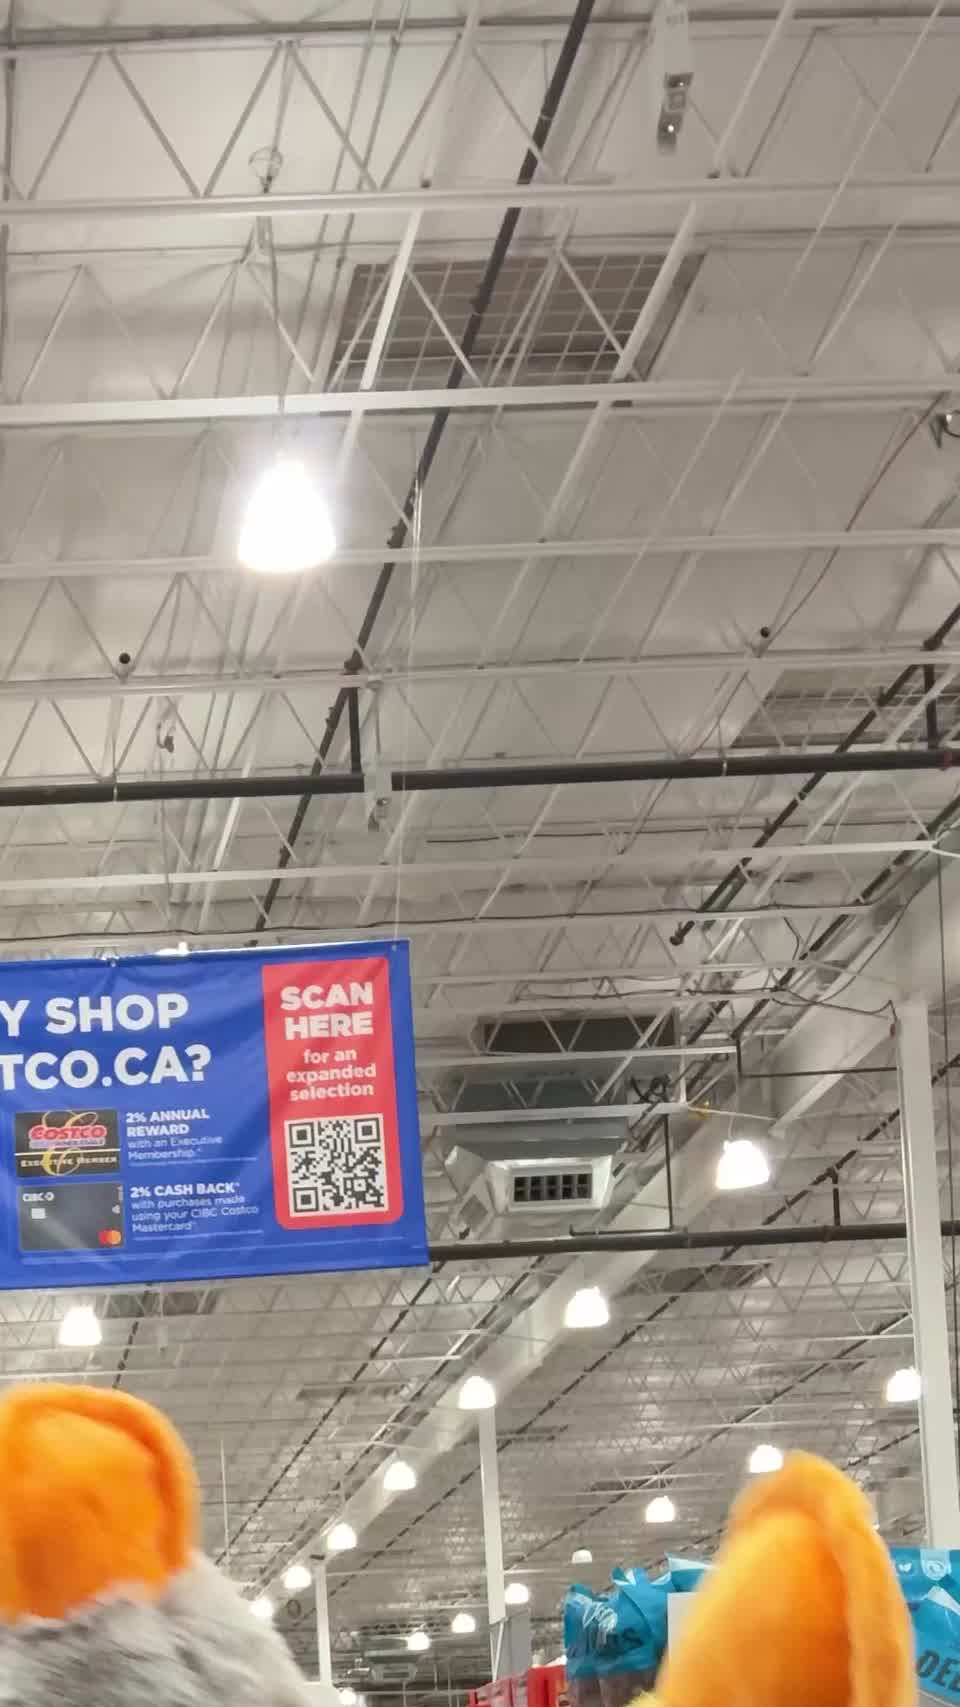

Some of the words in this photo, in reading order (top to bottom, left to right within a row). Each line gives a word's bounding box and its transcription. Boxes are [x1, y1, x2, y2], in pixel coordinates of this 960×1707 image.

[280, 981, 374, 1011] SCAN
[44, 992, 190, 1035] SHOP
[284, 1011, 374, 1040] HERE
[303, 1048, 330, 1064] for
[334, 1048, 357, 1062] an
[286, 1062, 377, 1085] expanded
[289, 1082, 375, 1102] selection
[126, 1112, 147, 1124] 2%
[150, 1108, 210, 1122] ANNUAL
[28, 1125, 108, 1140] COSTCO
[126, 1123, 190, 1137] REWARD
[128, 1139, 152, 1149] with
[170, 1136, 223, 1147] Executive
[20, 1157, 75, 1168] EXECTIVE
[130, 1187, 152, 1198] 2%
[154, 1184, 193, 1196] CASH
[132, 1200, 155, 1209] with
[157, 1197, 212, 1209] purchases
[215, 1195, 245, 1205] made
[132, 1211, 160, 1222] using
[164, 1210, 189, 1221] your
[191, 1207, 218, 1218] CIBC
[221, 1206, 259, 1216] Costco
